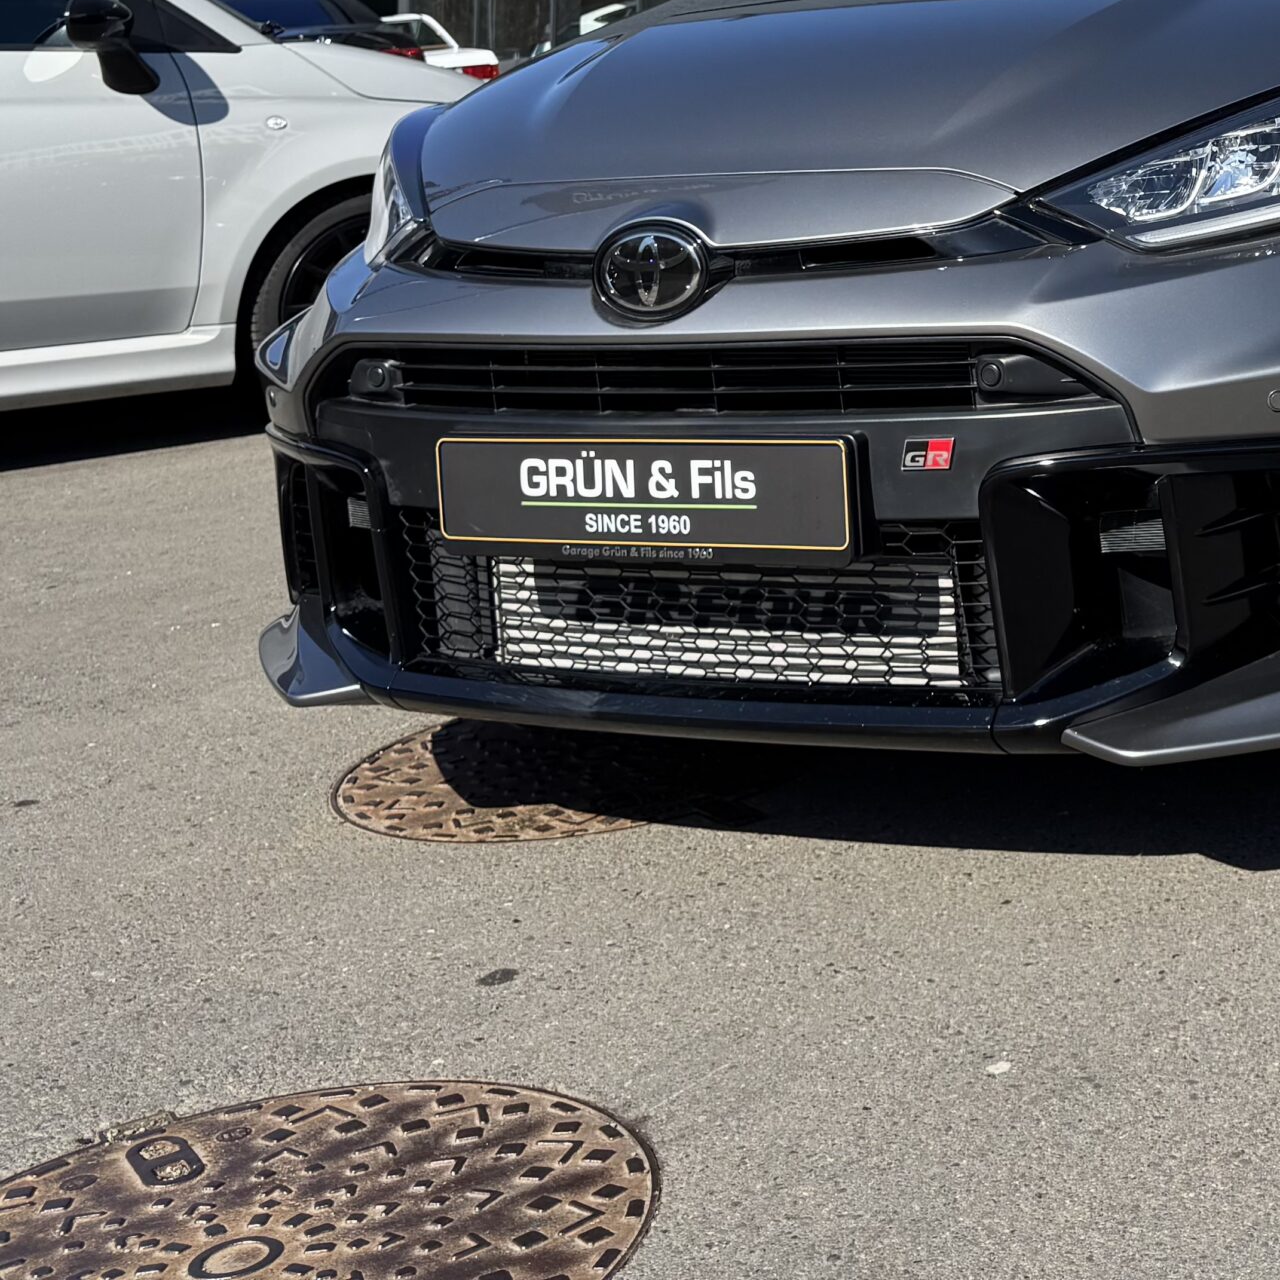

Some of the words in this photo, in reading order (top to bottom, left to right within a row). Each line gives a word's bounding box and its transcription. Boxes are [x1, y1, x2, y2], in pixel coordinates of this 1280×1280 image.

[904, 451, 949, 467] GR
[519, 450, 635, 498] GRÜN
[648, 459, 680, 499] &
[690, 459, 757, 500] Fils
[585, 513, 643, 534] SINCE
[647, 514, 691, 535] 1960
[561, 544, 600, 558] Garage
[602, 546, 627, 557] Grün
[629, 547, 639, 557] &
[640, 547, 657, 558] Fils
[659, 548, 685, 559] since
[687, 548, 714, 560] 1960
